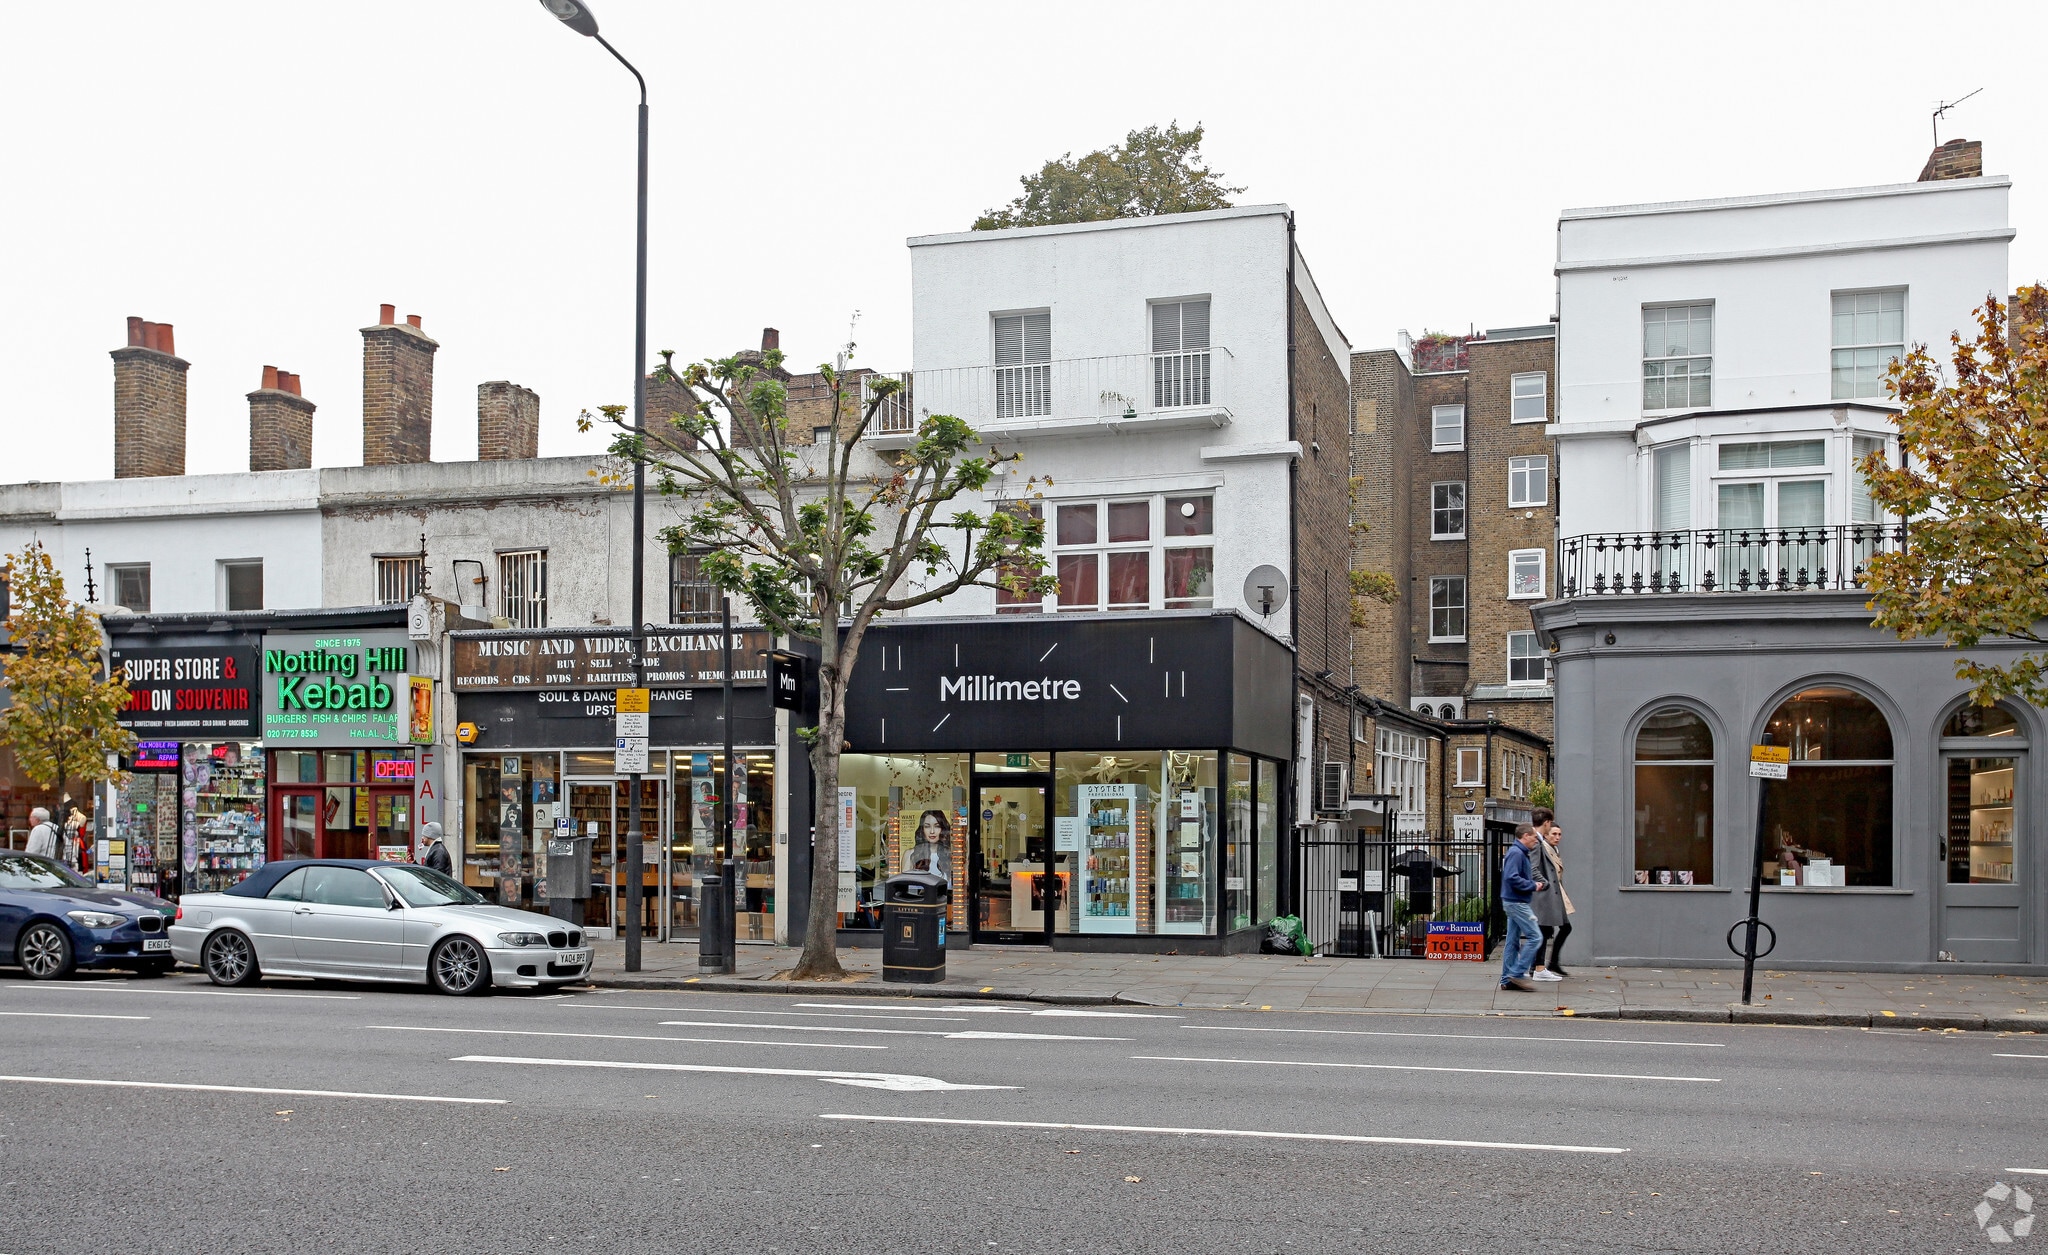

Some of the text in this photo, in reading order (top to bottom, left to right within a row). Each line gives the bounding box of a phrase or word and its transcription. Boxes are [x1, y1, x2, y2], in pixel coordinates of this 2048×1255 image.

[343, 638, 361, 647] 1975
[479, 640, 531, 657] MUSIC
[539, 639, 575, 655] AND
[124, 656, 238, 681] SUPER STORE &
[265, 647, 406, 679] Notting Hill
[557, 657, 660, 669] BUY SELL TADE
[457, 676, 499, 686] RECORDS
[512, 674, 531, 684] CDS
[546, 674, 571, 684] DVDS
[646, 671, 686, 682] PROMOS
[698, 669, 768, 681] MEMOABILIA
[780, 672, 796, 691] Mm
[278, 675, 393, 710] Kebab
[940, 675, 1081, 701] Millimetre
[124, 688, 250, 711] NDON SOUVENIR
[538, 690, 693, 702] SOUL & DANC HANGE
[586, 704, 616, 716] UPST
[266, 714, 398, 724] BURGERS FISH & CHIPS FALAF
[266, 730, 318, 738] 020 7727 8536
[350, 729, 380, 738] HALAL
[377, 762, 414, 777] OPEN
[560, 819, 567, 828] P
[1450, 924, 1482, 932] Barnard
[148, 940, 172, 949] EK61 CS
[1431, 941, 1479, 952] TO LET
[560, 954, 576, 963] YA04
